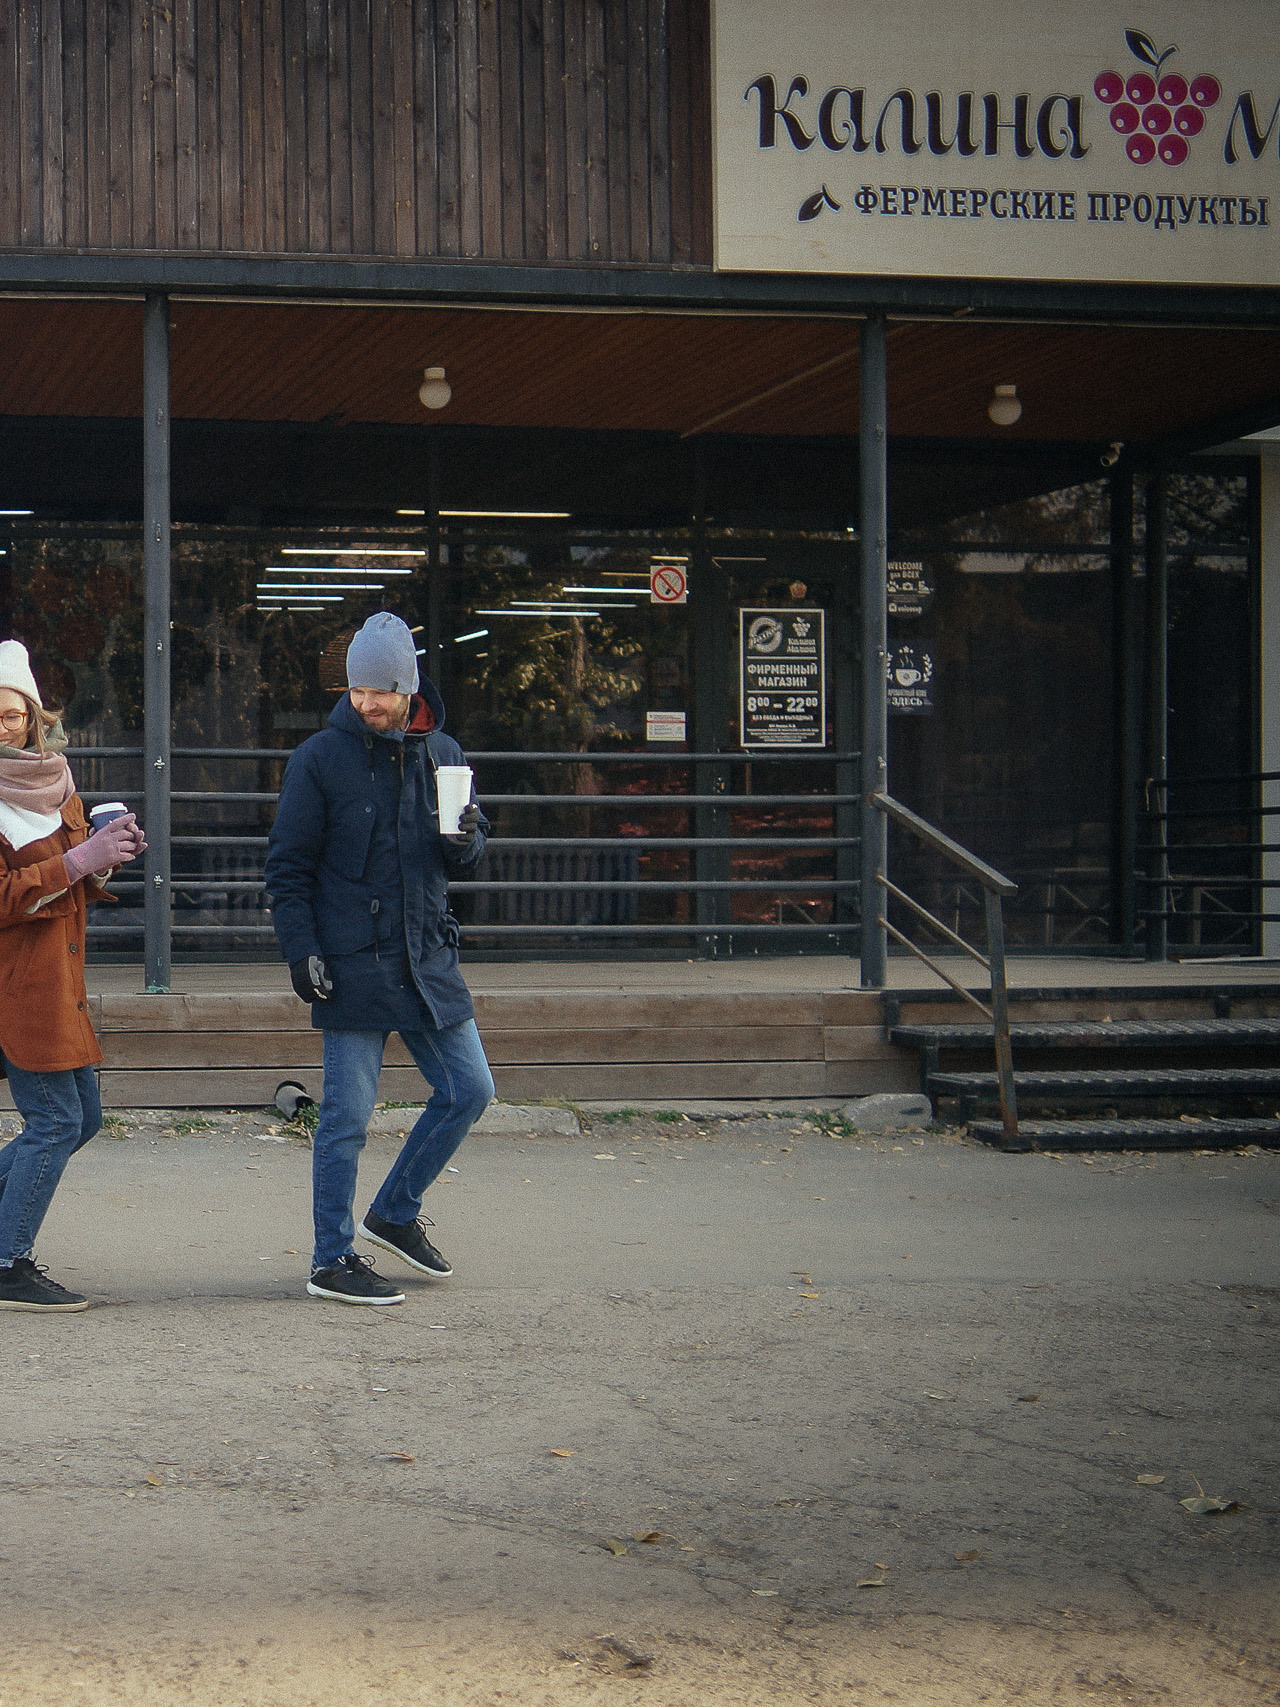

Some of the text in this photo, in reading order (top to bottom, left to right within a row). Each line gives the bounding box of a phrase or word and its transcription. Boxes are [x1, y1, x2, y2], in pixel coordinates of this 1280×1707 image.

[743, 73, 1091, 160] Калина
[854, 184, 1270, 231] ФЕРМЕРСКИЕ ПРОДУКТЫ
[887, 561, 923, 571] WELCOME
[747, 662, 818, 674] ФИРМЕННЫЙ
[758, 676, 807, 687] МАГАЗИН
[891, 696, 923, 706] ЗДЕСЬ
